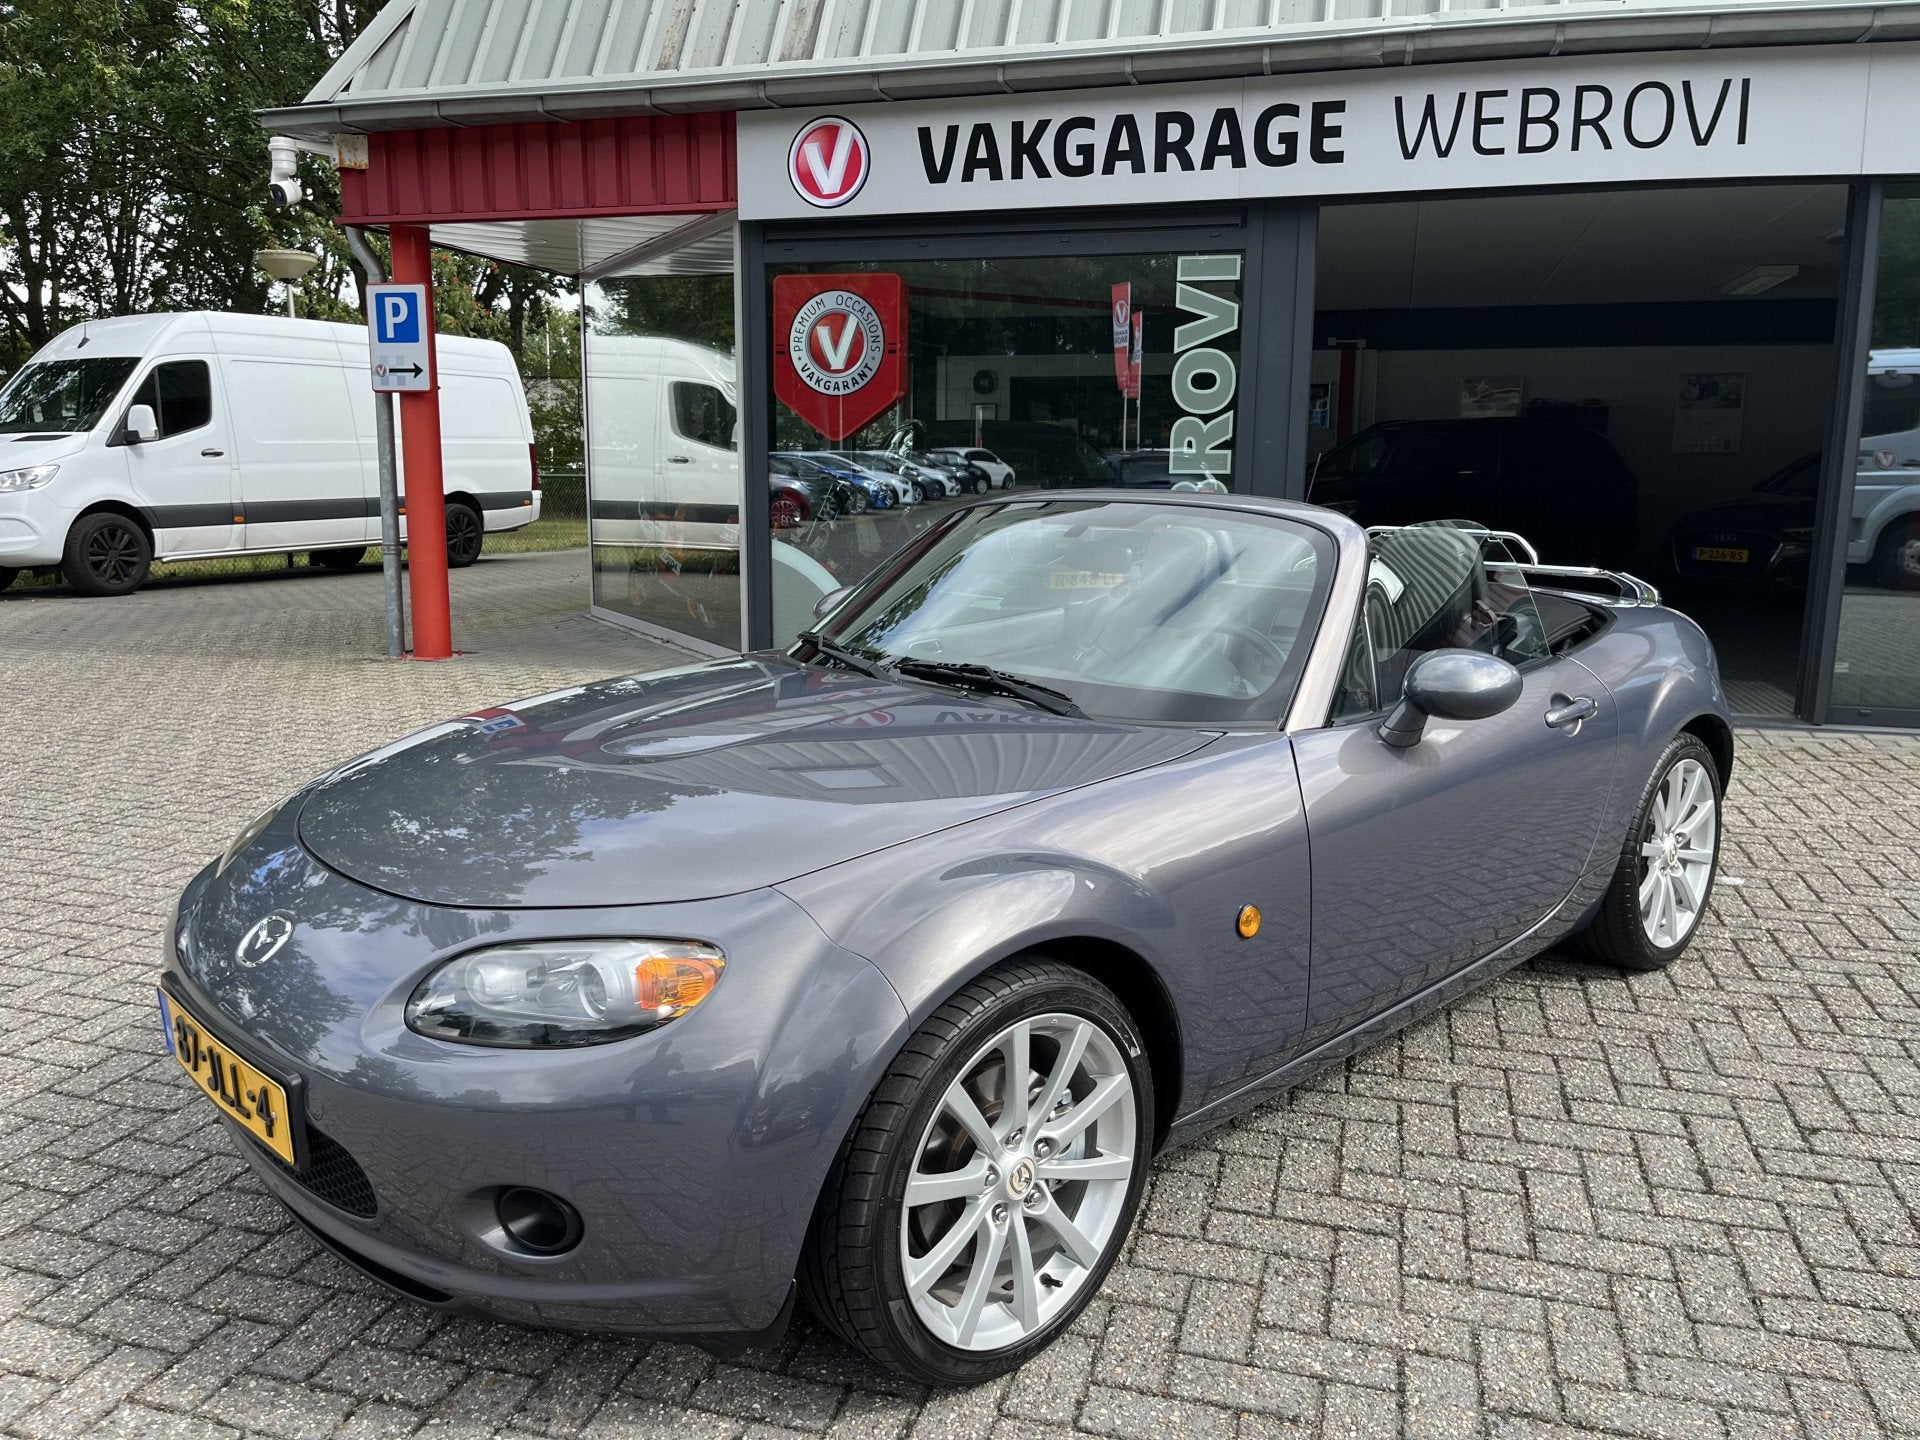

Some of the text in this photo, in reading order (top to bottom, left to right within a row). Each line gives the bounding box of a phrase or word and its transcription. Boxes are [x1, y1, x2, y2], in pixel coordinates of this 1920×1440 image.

[917, 77, 1752, 185] VAKGARAGE WEBROVI
[384, 296, 408, 339] P
[793, 294, 881, 353] PREMIUM OCCASIONS
[800, 362, 874, 392] VAKGARANT
[1699, 549, 1744, 561] P-236-RS
[175, 1015, 275, 1138] 87-JLL-4
